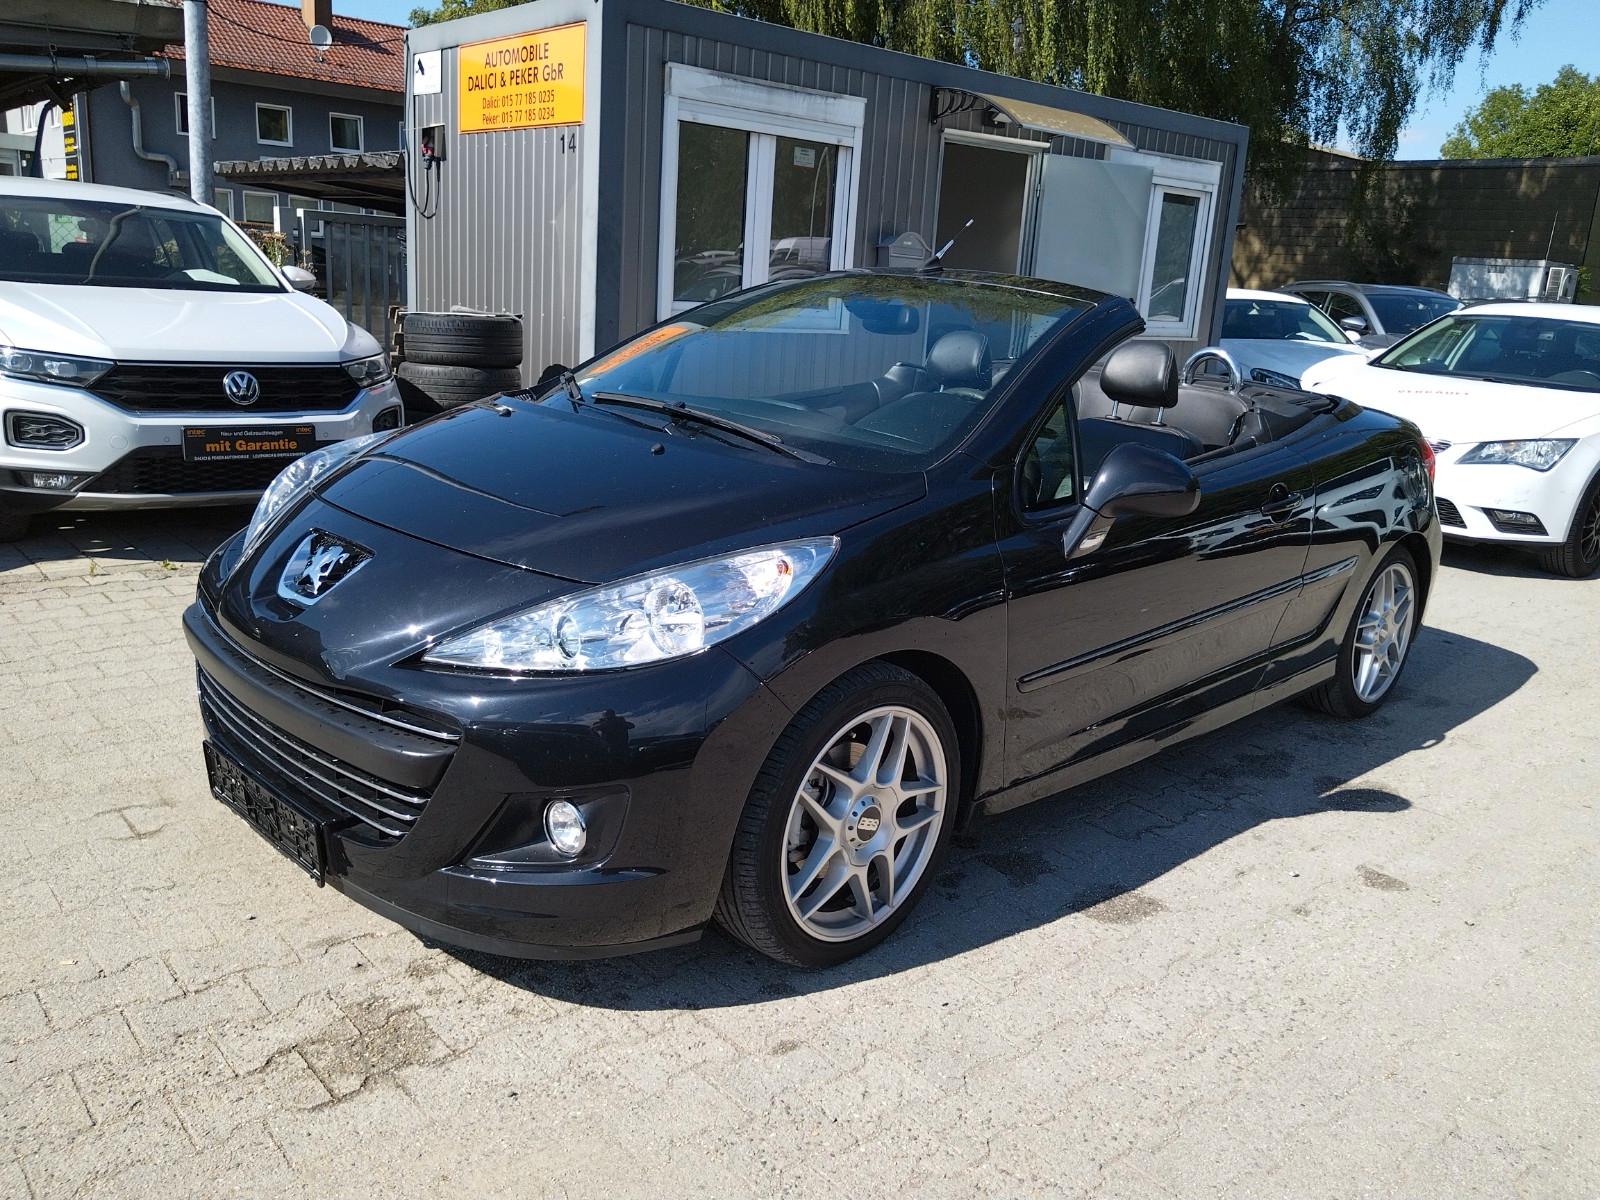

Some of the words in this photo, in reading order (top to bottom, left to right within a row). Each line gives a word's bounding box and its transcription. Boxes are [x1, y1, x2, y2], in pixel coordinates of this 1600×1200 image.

[484, 43, 549, 69] AUTOMOBILE
[468, 72, 497, 92] DALICI
[500, 73, 507, 88] &
[509, 67, 539, 86] PEKER
[542, 63, 564, 82] GbR
[482, 94, 501, 110] Dalici:
[501, 95, 513, 107] 015
[515, 94, 523, 106] 77
[525, 92, 537, 105] 185
[538, 89, 555, 104] 0235
[482, 112, 501, 126] Peker:
[501, 111, 513, 124] 015
[515, 110, 523, 122] 77
[525, 109, 537, 121] 185
[538, 107, 555, 121] 0234
[560, 133, 577, 154] 14
[205, 440, 231, 452] mit
[235, 439, 298, 451] Garantie
